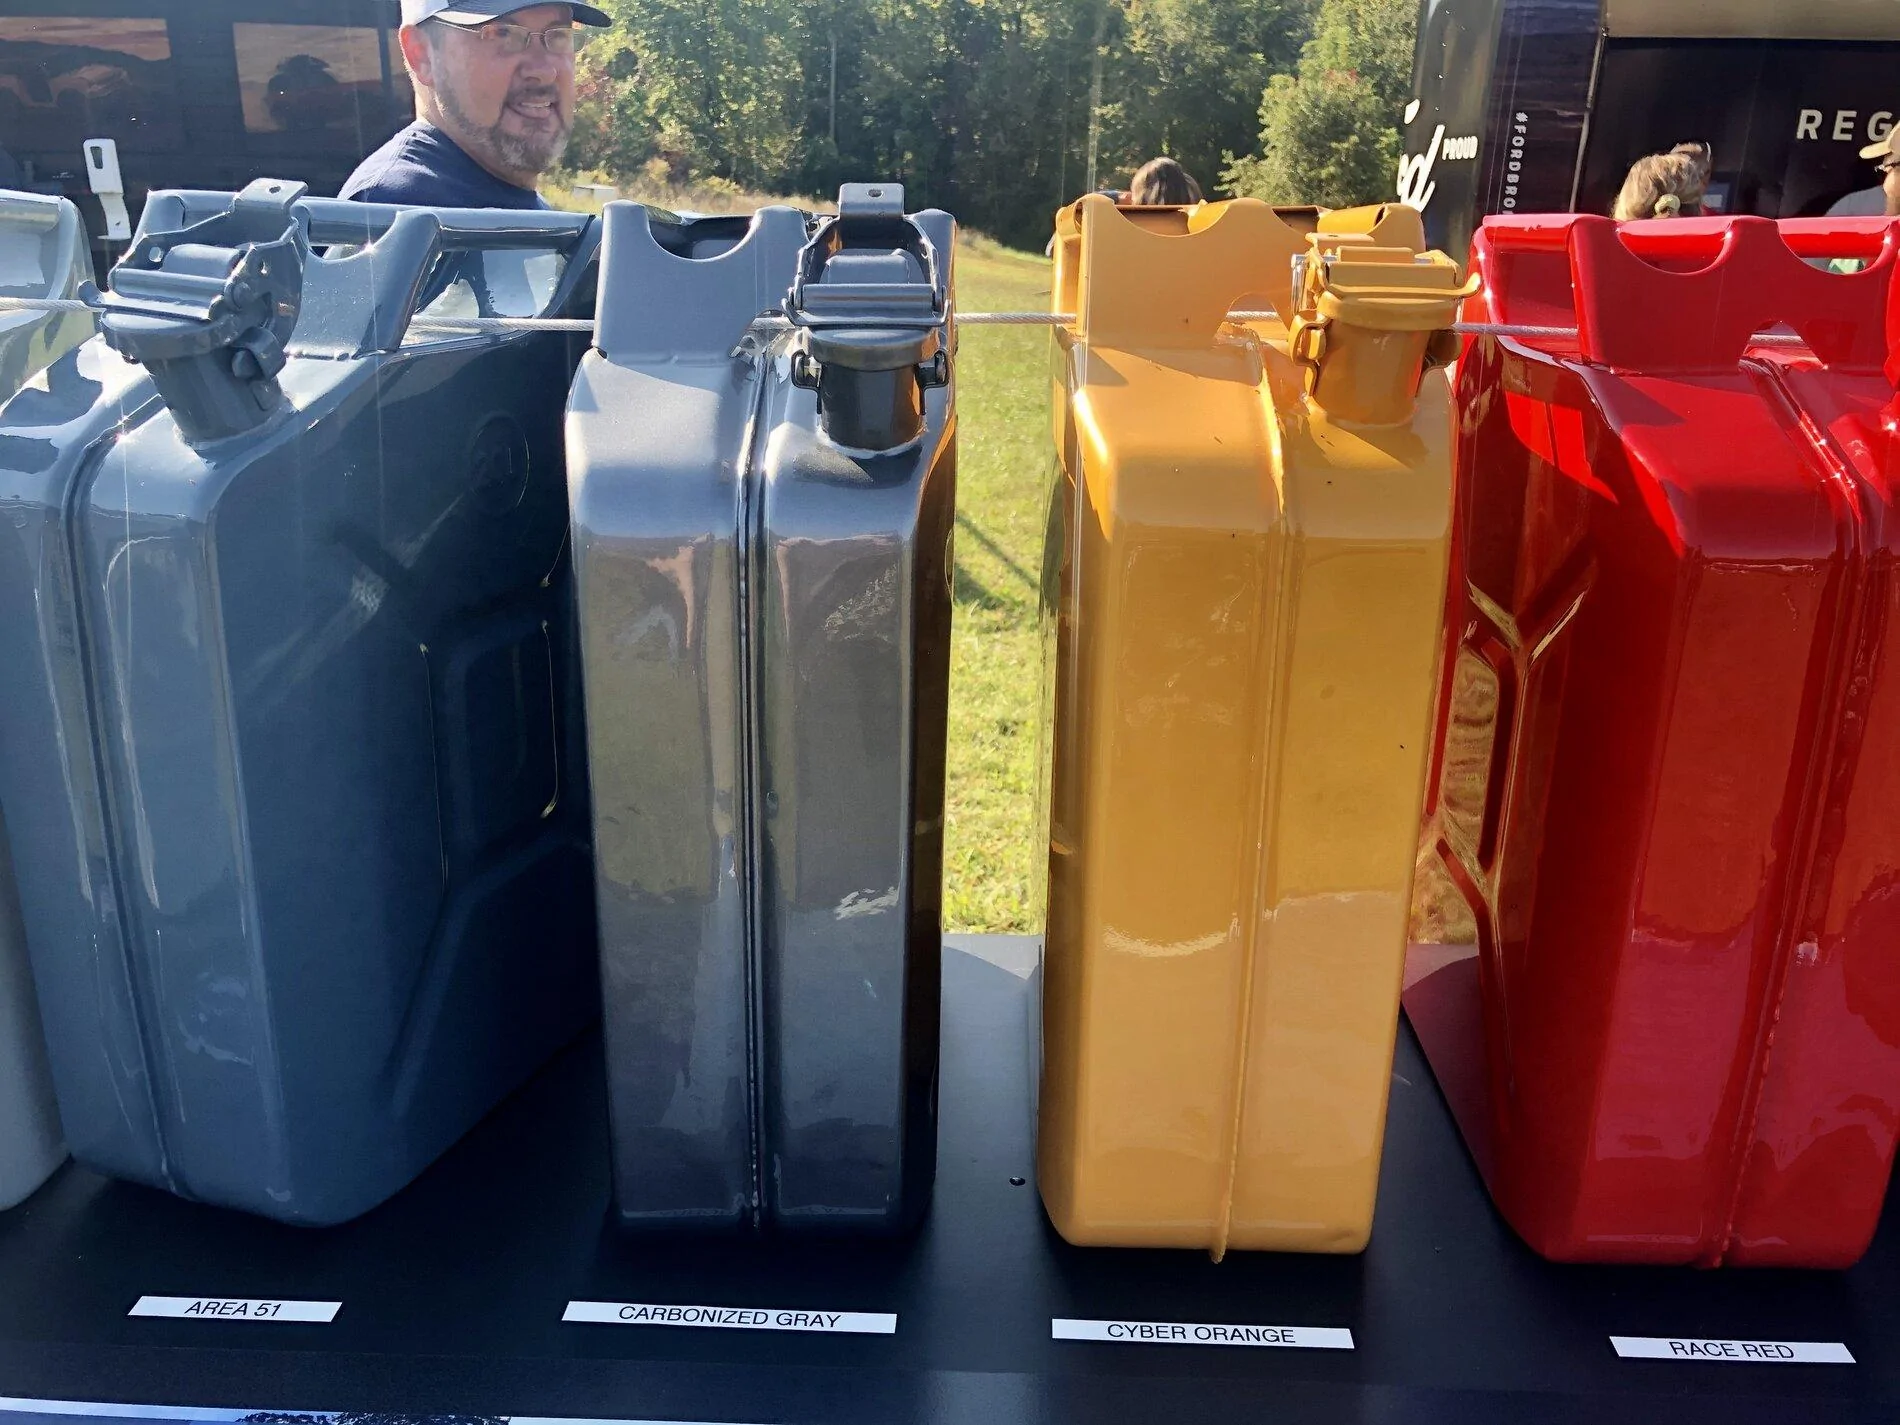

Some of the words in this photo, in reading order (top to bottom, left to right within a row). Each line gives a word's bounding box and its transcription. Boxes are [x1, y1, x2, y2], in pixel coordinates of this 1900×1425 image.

[1442, 135, 1478, 160] PROUD
[184, 1301, 249, 1316] AREA
[253, 1303, 282, 1317] 51
[618, 1305, 769, 1325] CARBONIZED
[776, 1312, 842, 1328] GRAY
[1107, 1323, 1187, 1340] CYBER
[1194, 1326, 1296, 1343] ORANGE
[1669, 1341, 1740, 1357] RACE
[1742, 1343, 1795, 1359] RED
